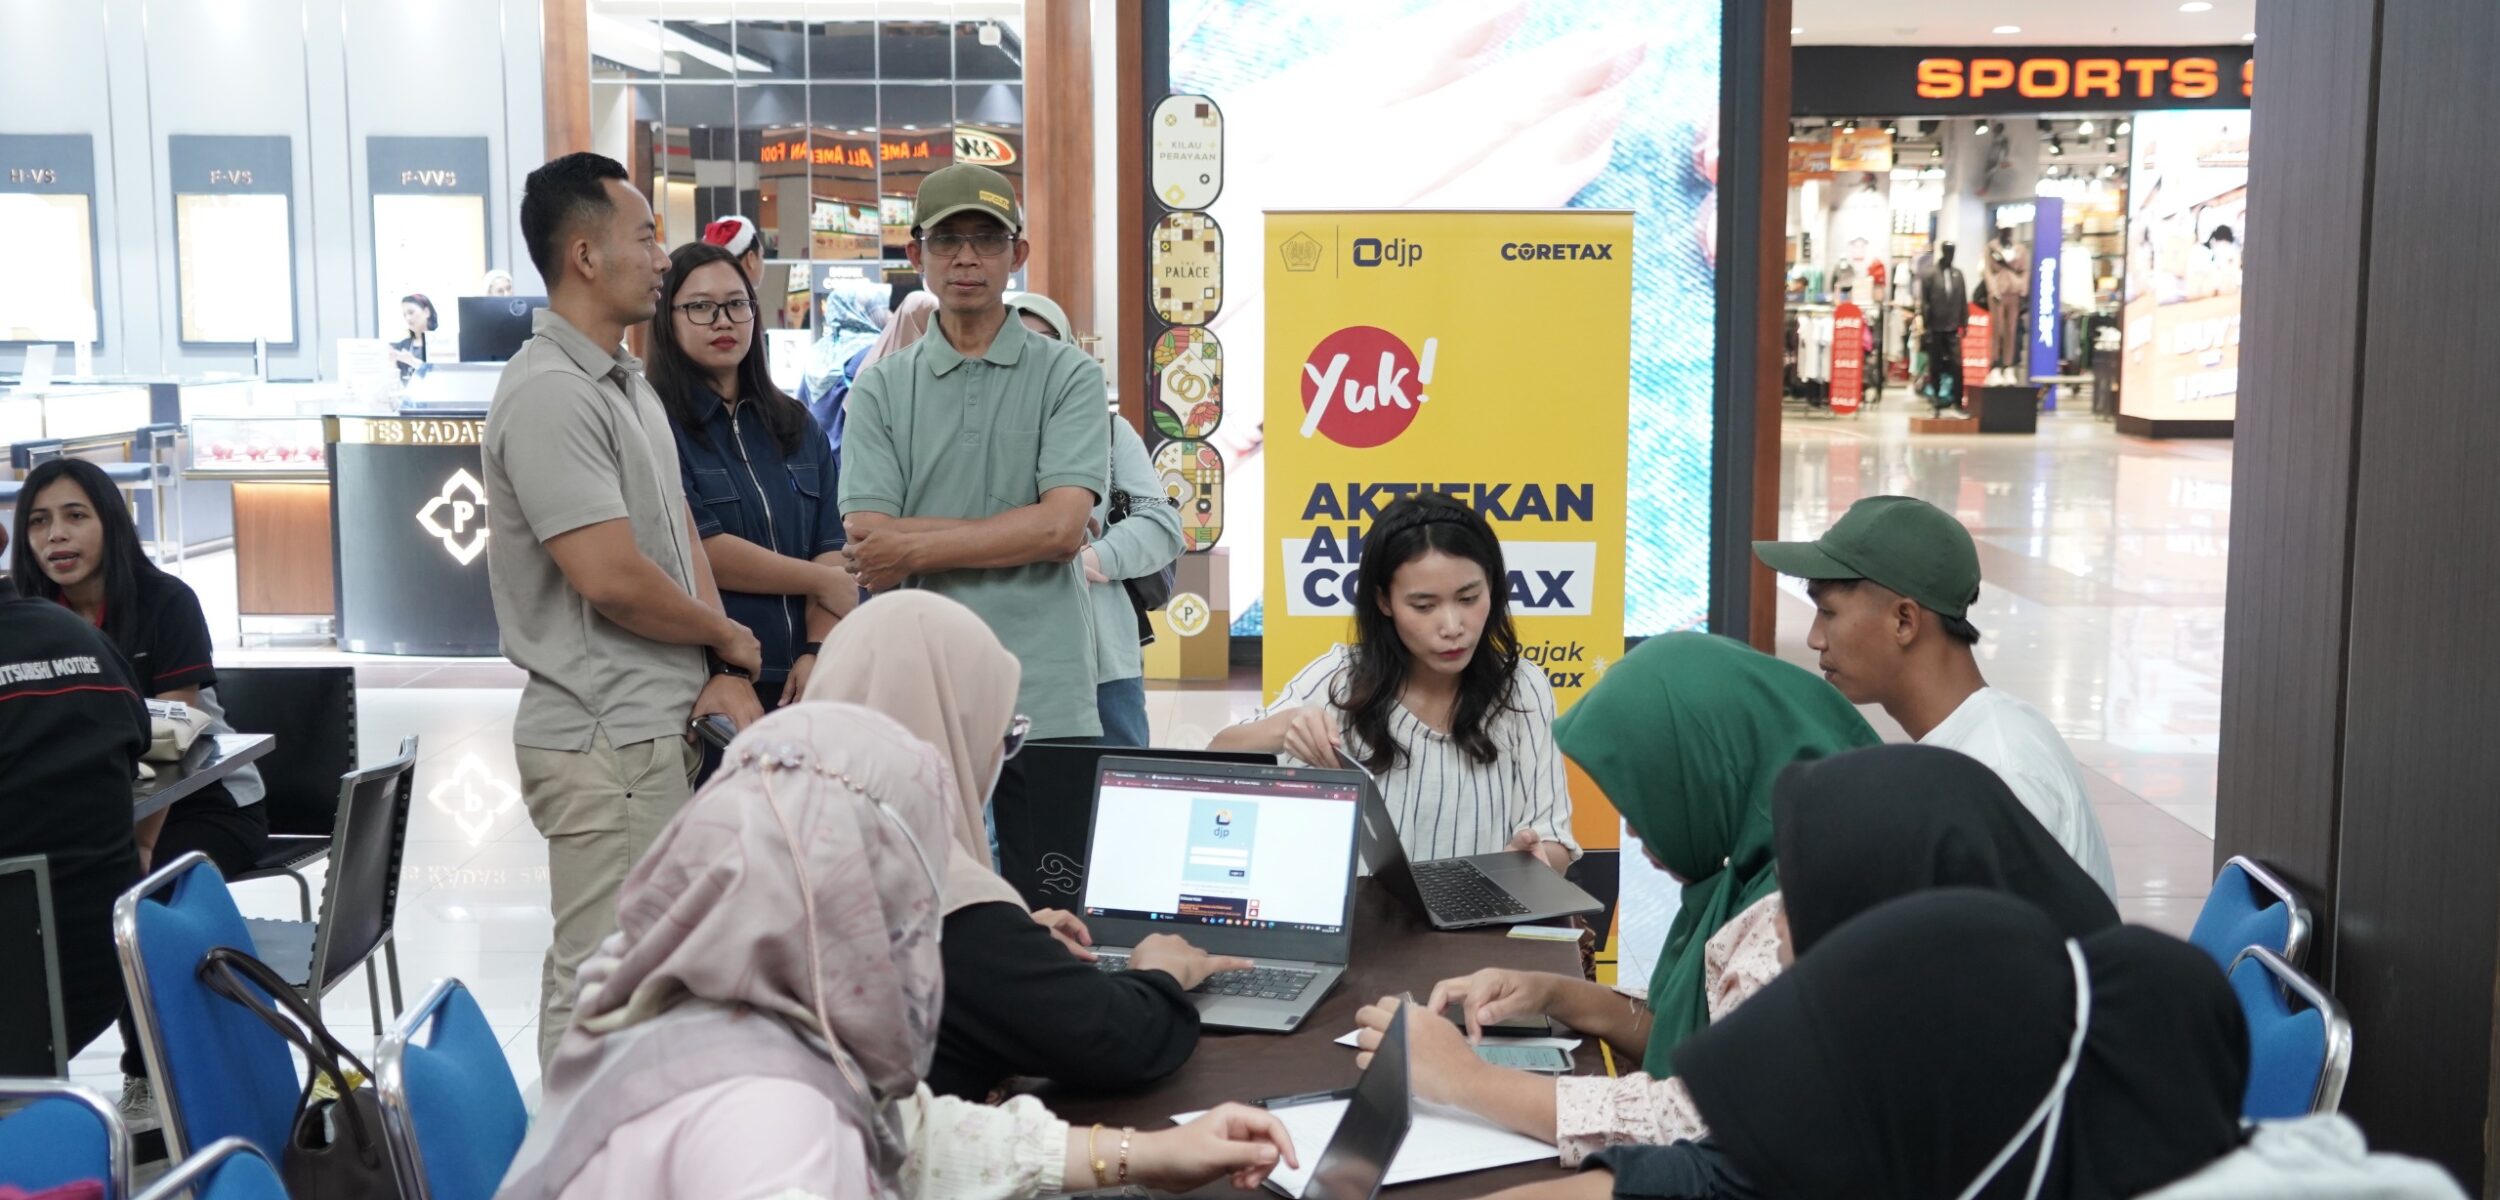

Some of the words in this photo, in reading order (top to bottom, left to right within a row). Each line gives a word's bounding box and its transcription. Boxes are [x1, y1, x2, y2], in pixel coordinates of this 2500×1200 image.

[1917, 57, 2219, 99] SPORTS
[1159, 153, 1217, 161] PERAYAAN
[1384, 238, 1424, 267] djp
[1500, 242, 1614, 261] CORETAX
[1165, 267, 1210, 278] PALACE
[1836, 318, 1861, 329] SALE
[1968, 315, 1989, 326] ALE
[1834, 359, 1858, 369] SALE
[1300, 337, 1438, 439] Yuk!
[1831, 397, 1857, 407] SALE
[366, 421, 404, 443] TES
[52, 656, 100, 676] MOTORS
[1213, 826, 1230, 839] djp
